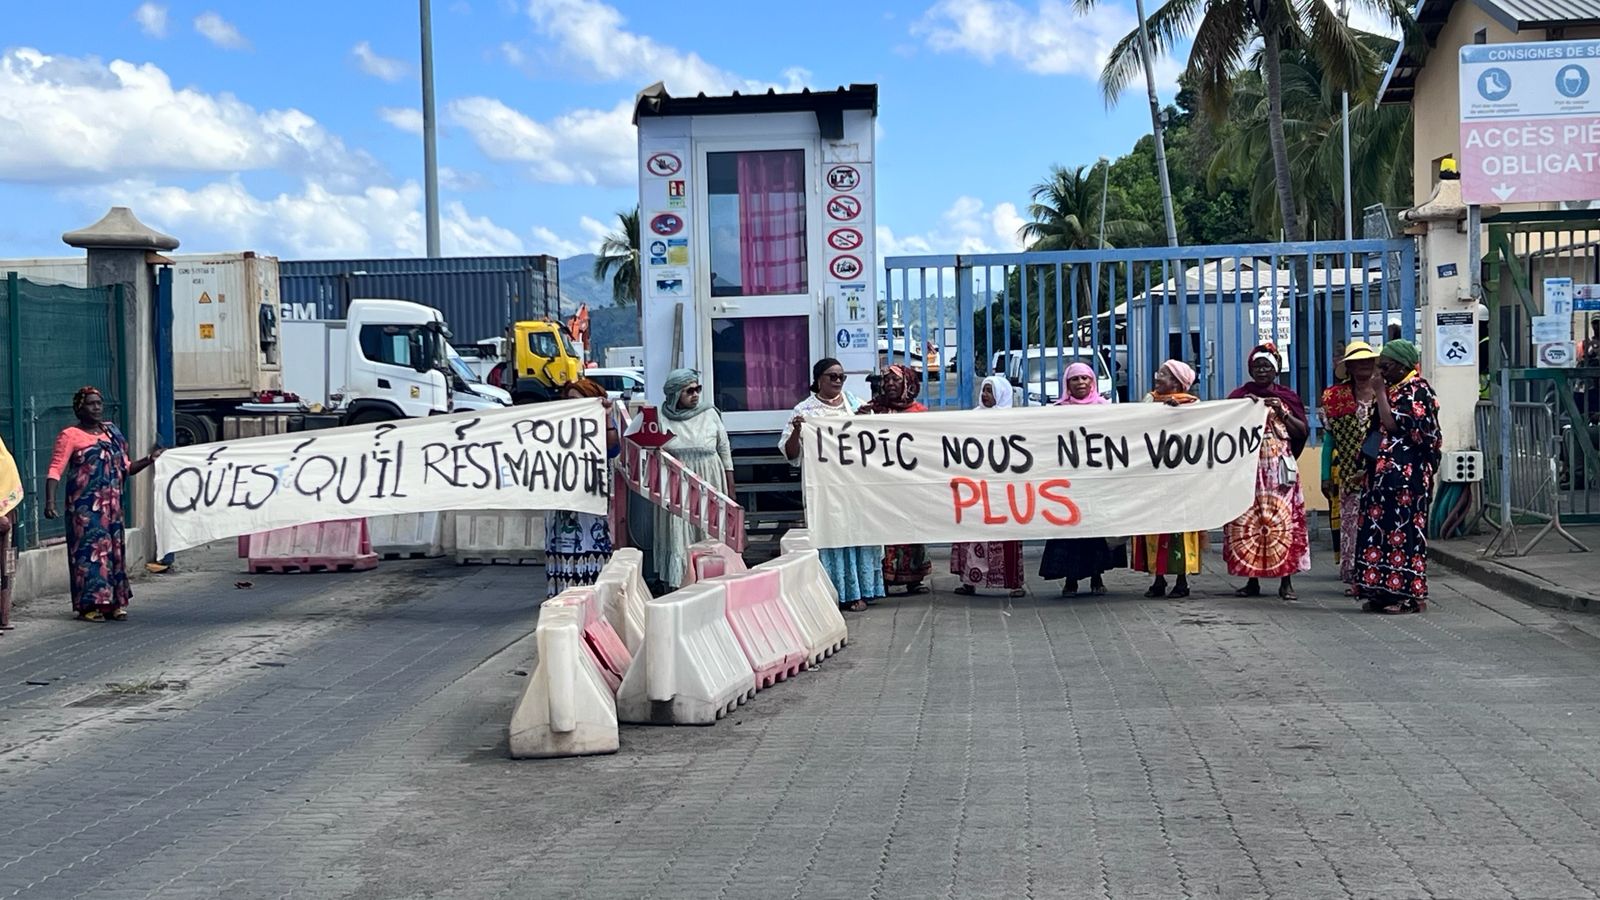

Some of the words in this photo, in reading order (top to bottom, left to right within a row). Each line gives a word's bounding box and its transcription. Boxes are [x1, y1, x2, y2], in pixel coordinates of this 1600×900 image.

[1488, 48, 1563, 60] CONSIGNES
[1566, 47, 1583, 57] DE
[1465, 122, 1555, 149] ACCÈS
[512, 417, 601, 455] POUR
[942, 434, 1034, 474] NOUS
[1057, 426, 1129, 470] N'EN
[950, 477, 1081, 526] PLUS
